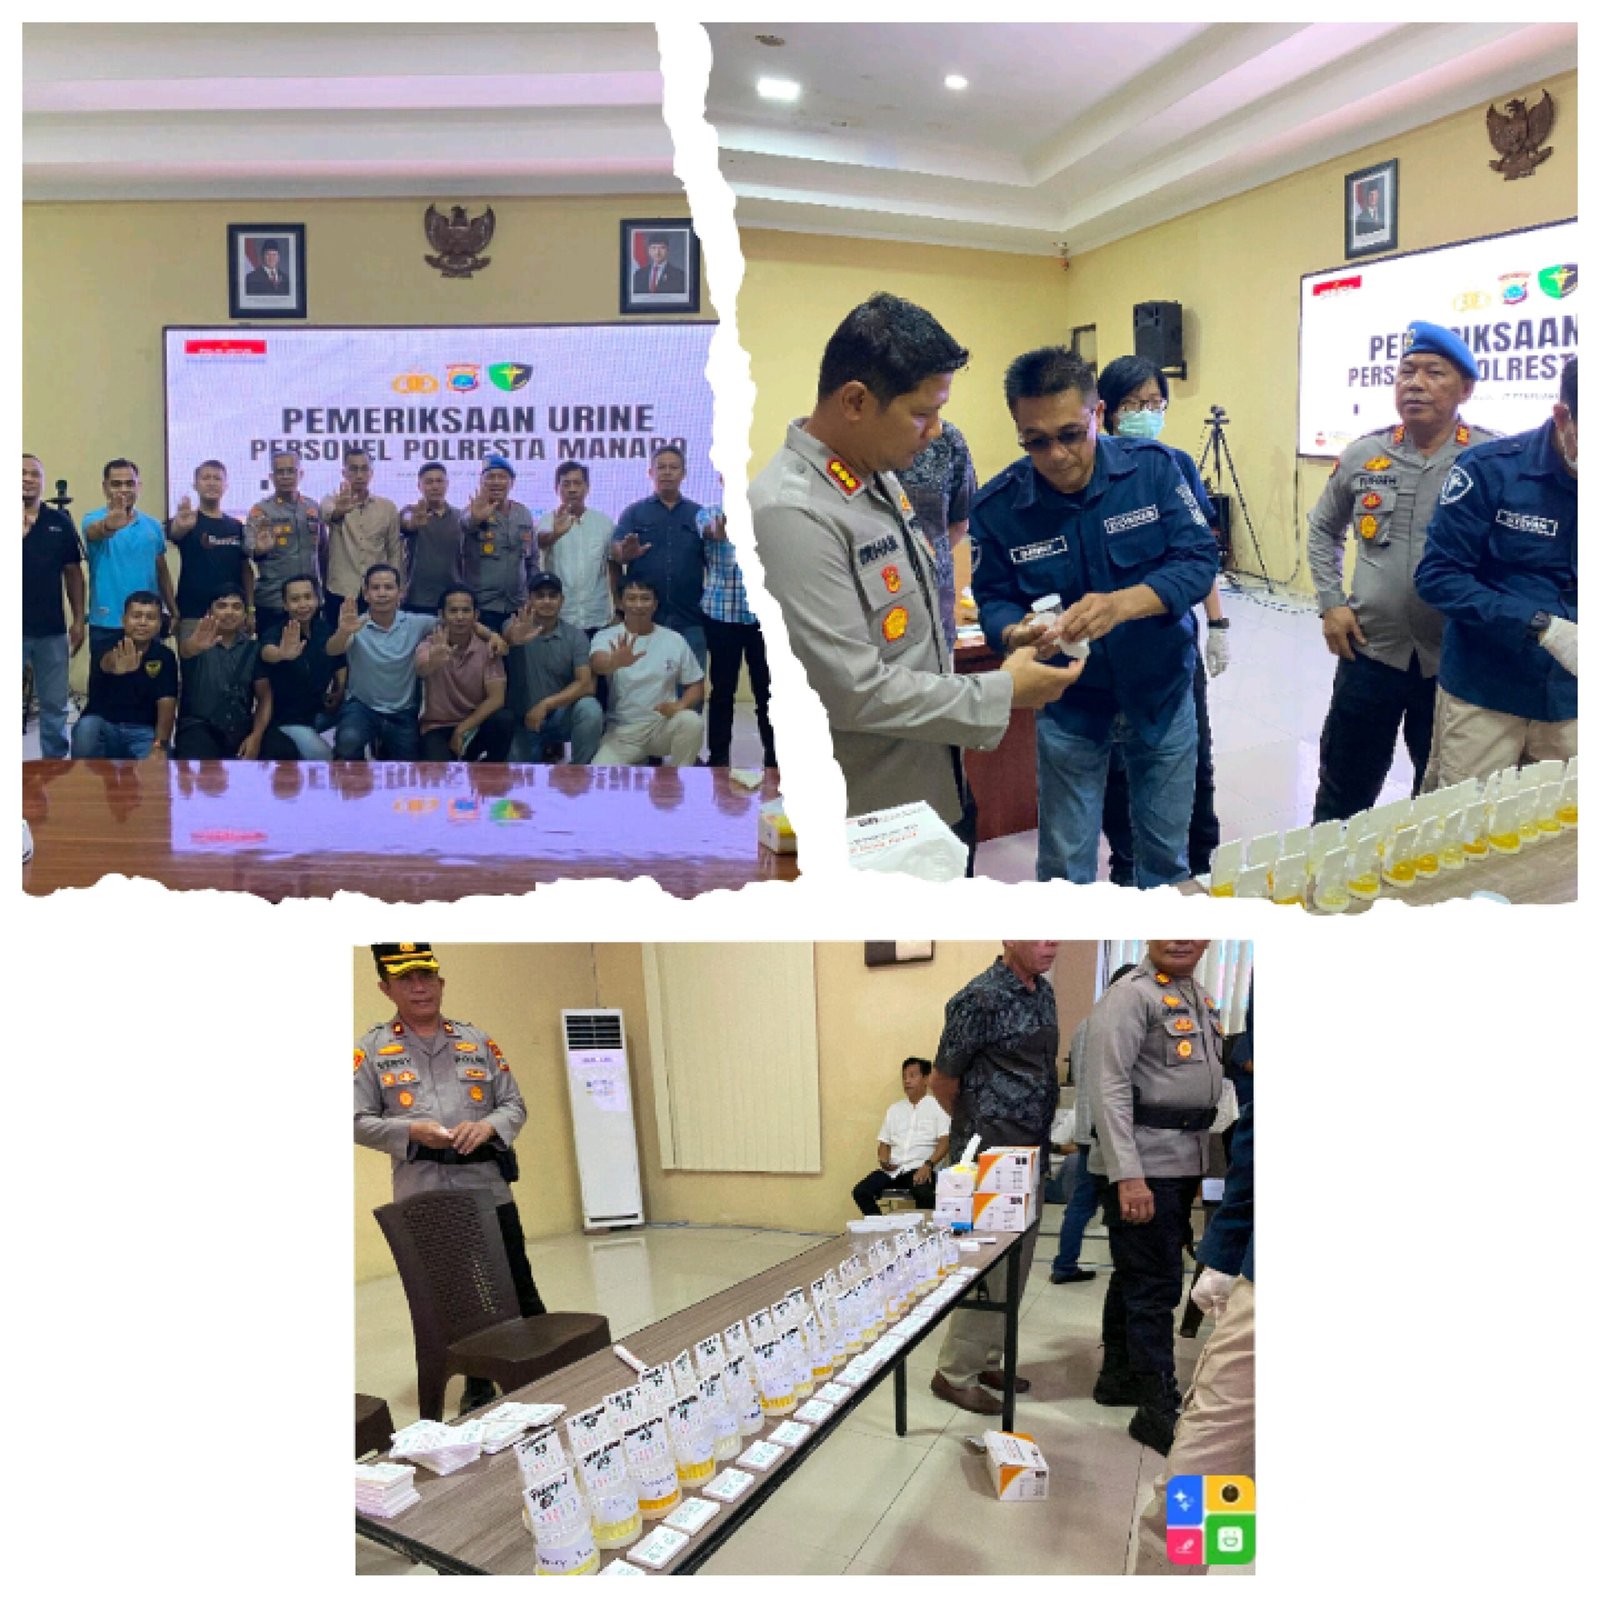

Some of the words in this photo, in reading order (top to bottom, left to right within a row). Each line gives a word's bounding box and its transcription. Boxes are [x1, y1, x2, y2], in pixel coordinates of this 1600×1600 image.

[282, 406, 535, 434] PEMERIKSAAN
[548, 406, 654, 432] URINE
[403, 438, 546, 461] POLRESTA
